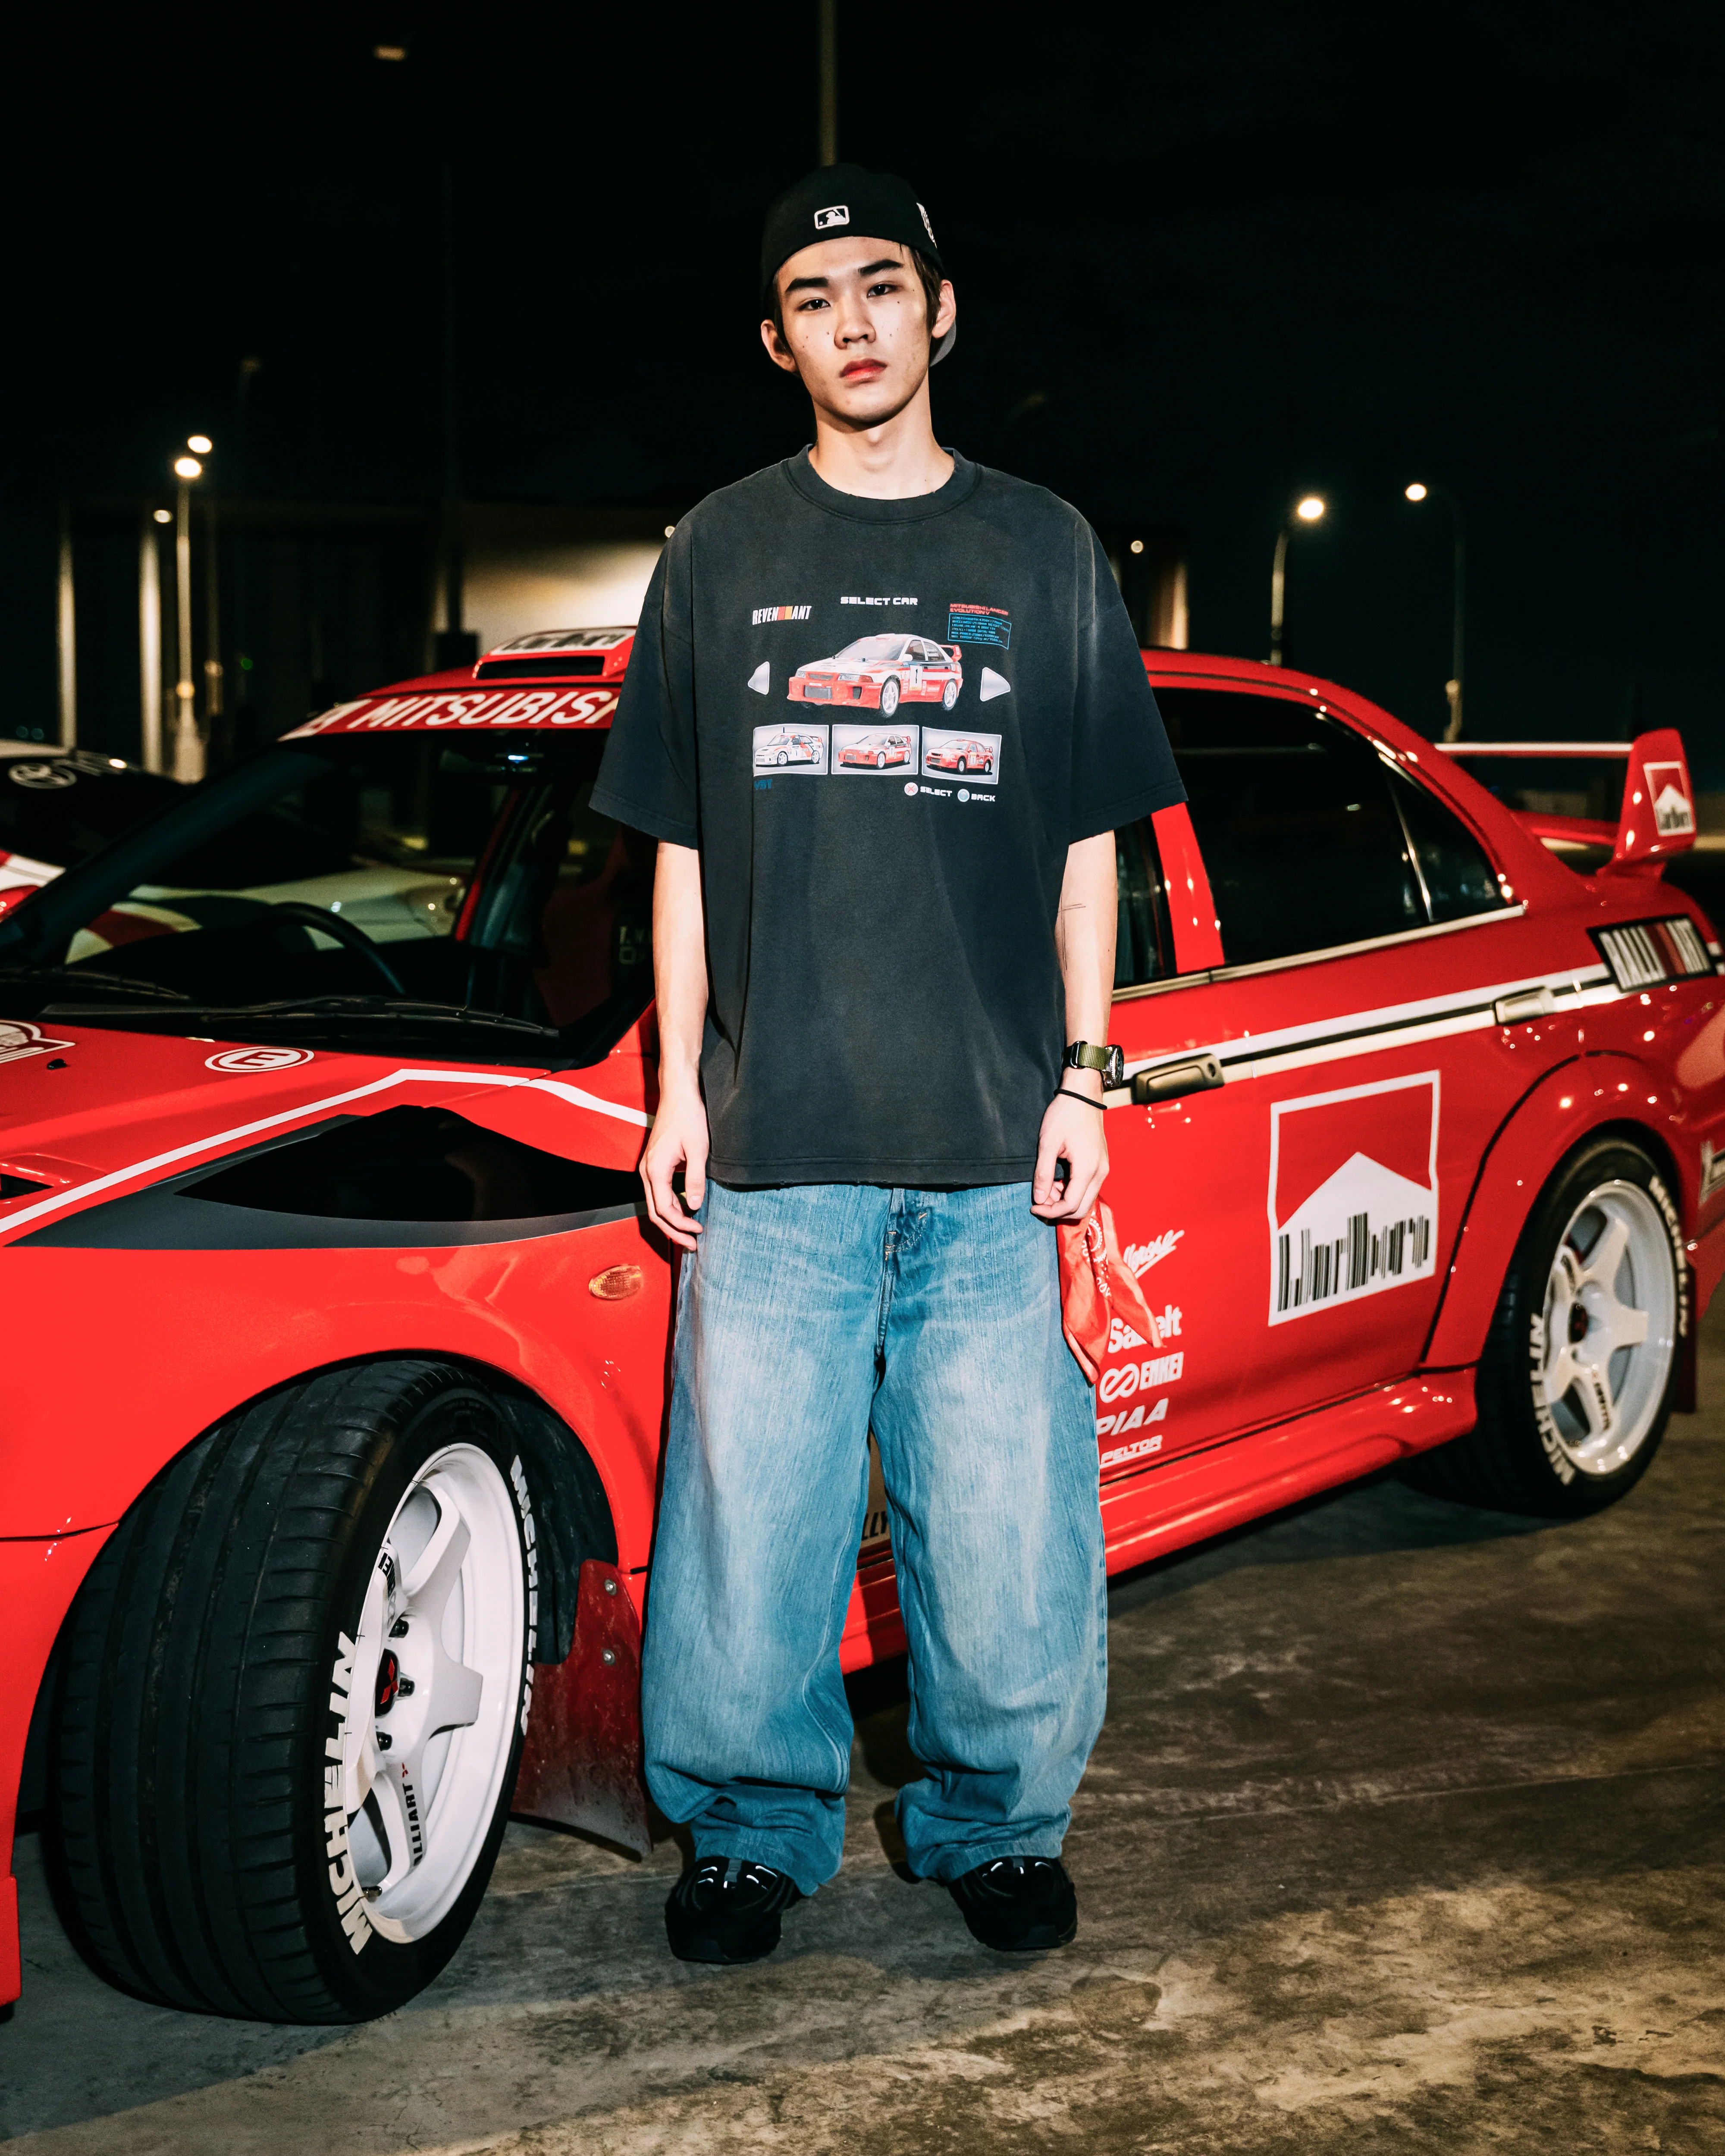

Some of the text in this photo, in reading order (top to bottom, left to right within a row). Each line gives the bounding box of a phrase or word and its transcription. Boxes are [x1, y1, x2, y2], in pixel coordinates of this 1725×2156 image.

[840, 596, 918, 605] SELECT CAR
[920, 786, 952, 797] SELECT
[971, 793, 996, 802] BACK
[1139, 1351, 1184, 1391] ENKEI
[1096, 1397, 1169, 1436] PIAA
[1101, 1434, 1164, 1465] PELTOR
[324, 1631, 373, 1955] MICHELIN
